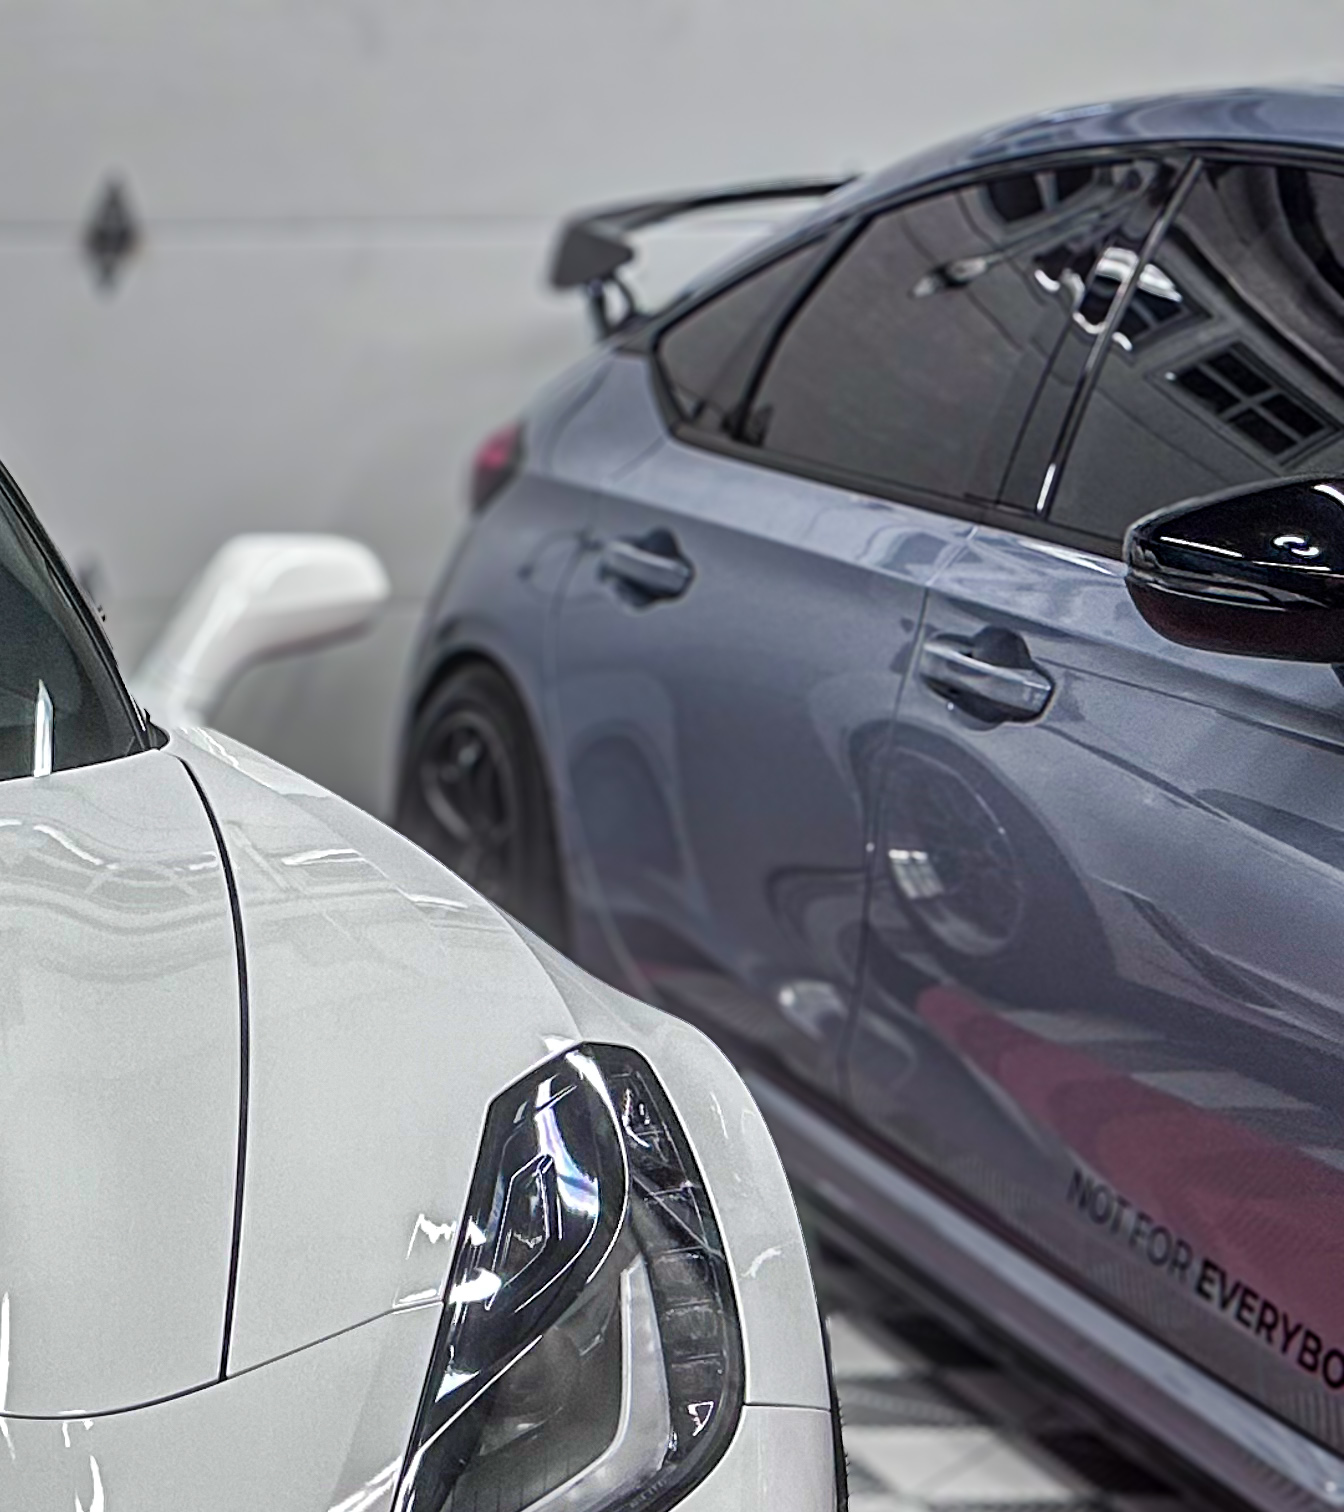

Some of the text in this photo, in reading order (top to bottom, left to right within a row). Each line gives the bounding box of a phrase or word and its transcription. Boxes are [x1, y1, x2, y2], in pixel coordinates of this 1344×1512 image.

[1067, 1165, 1344, 1389] NOT FOR EVERYBO
